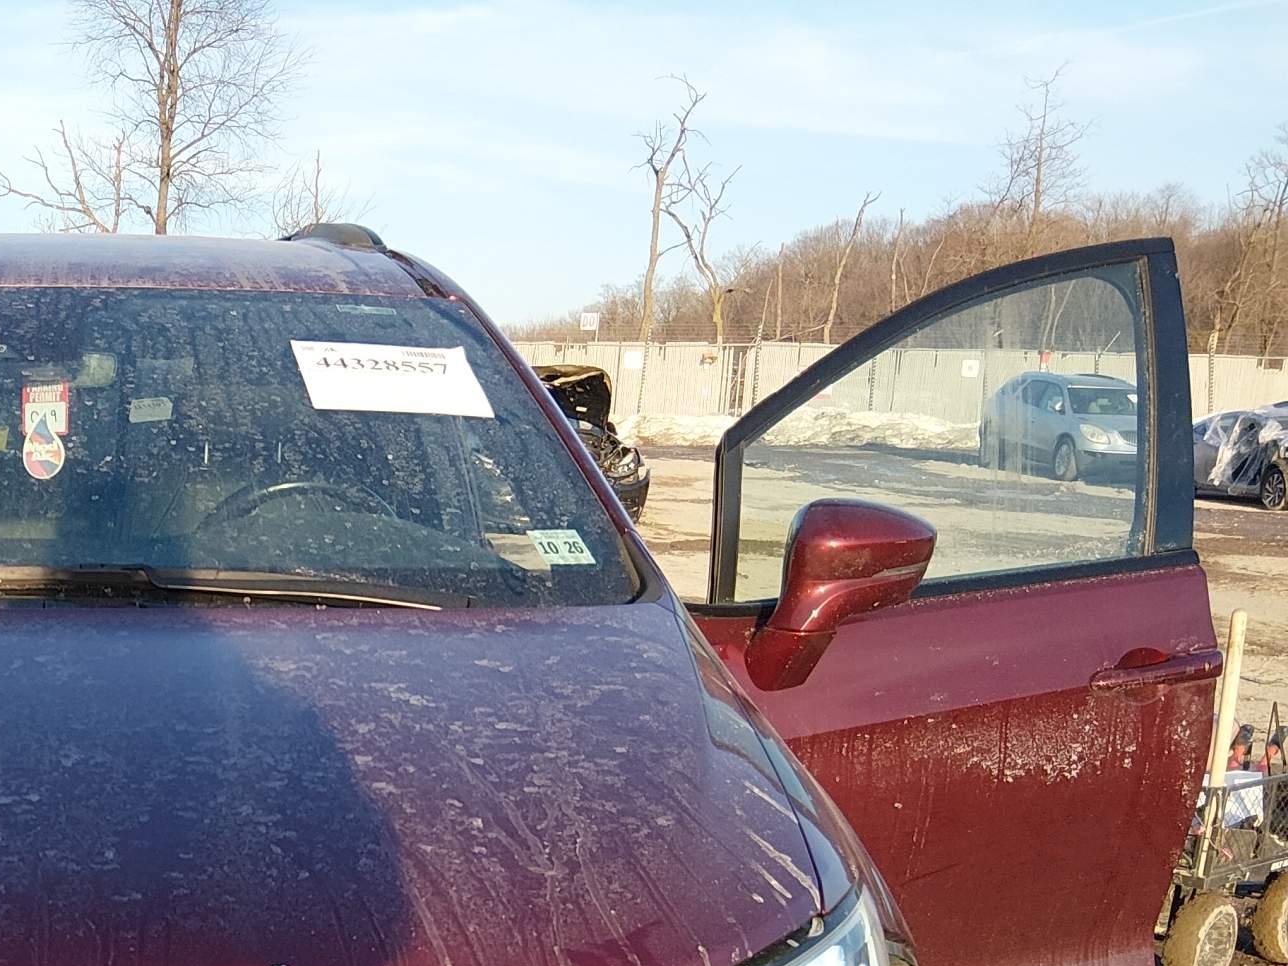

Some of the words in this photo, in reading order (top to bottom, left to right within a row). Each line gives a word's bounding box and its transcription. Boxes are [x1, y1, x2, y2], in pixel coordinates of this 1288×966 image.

[316, 357, 448, 375] 44328557
[29, 392, 62, 402] PERMIT
[538, 541, 559, 554] 10
[563, 541, 584, 554] 26
